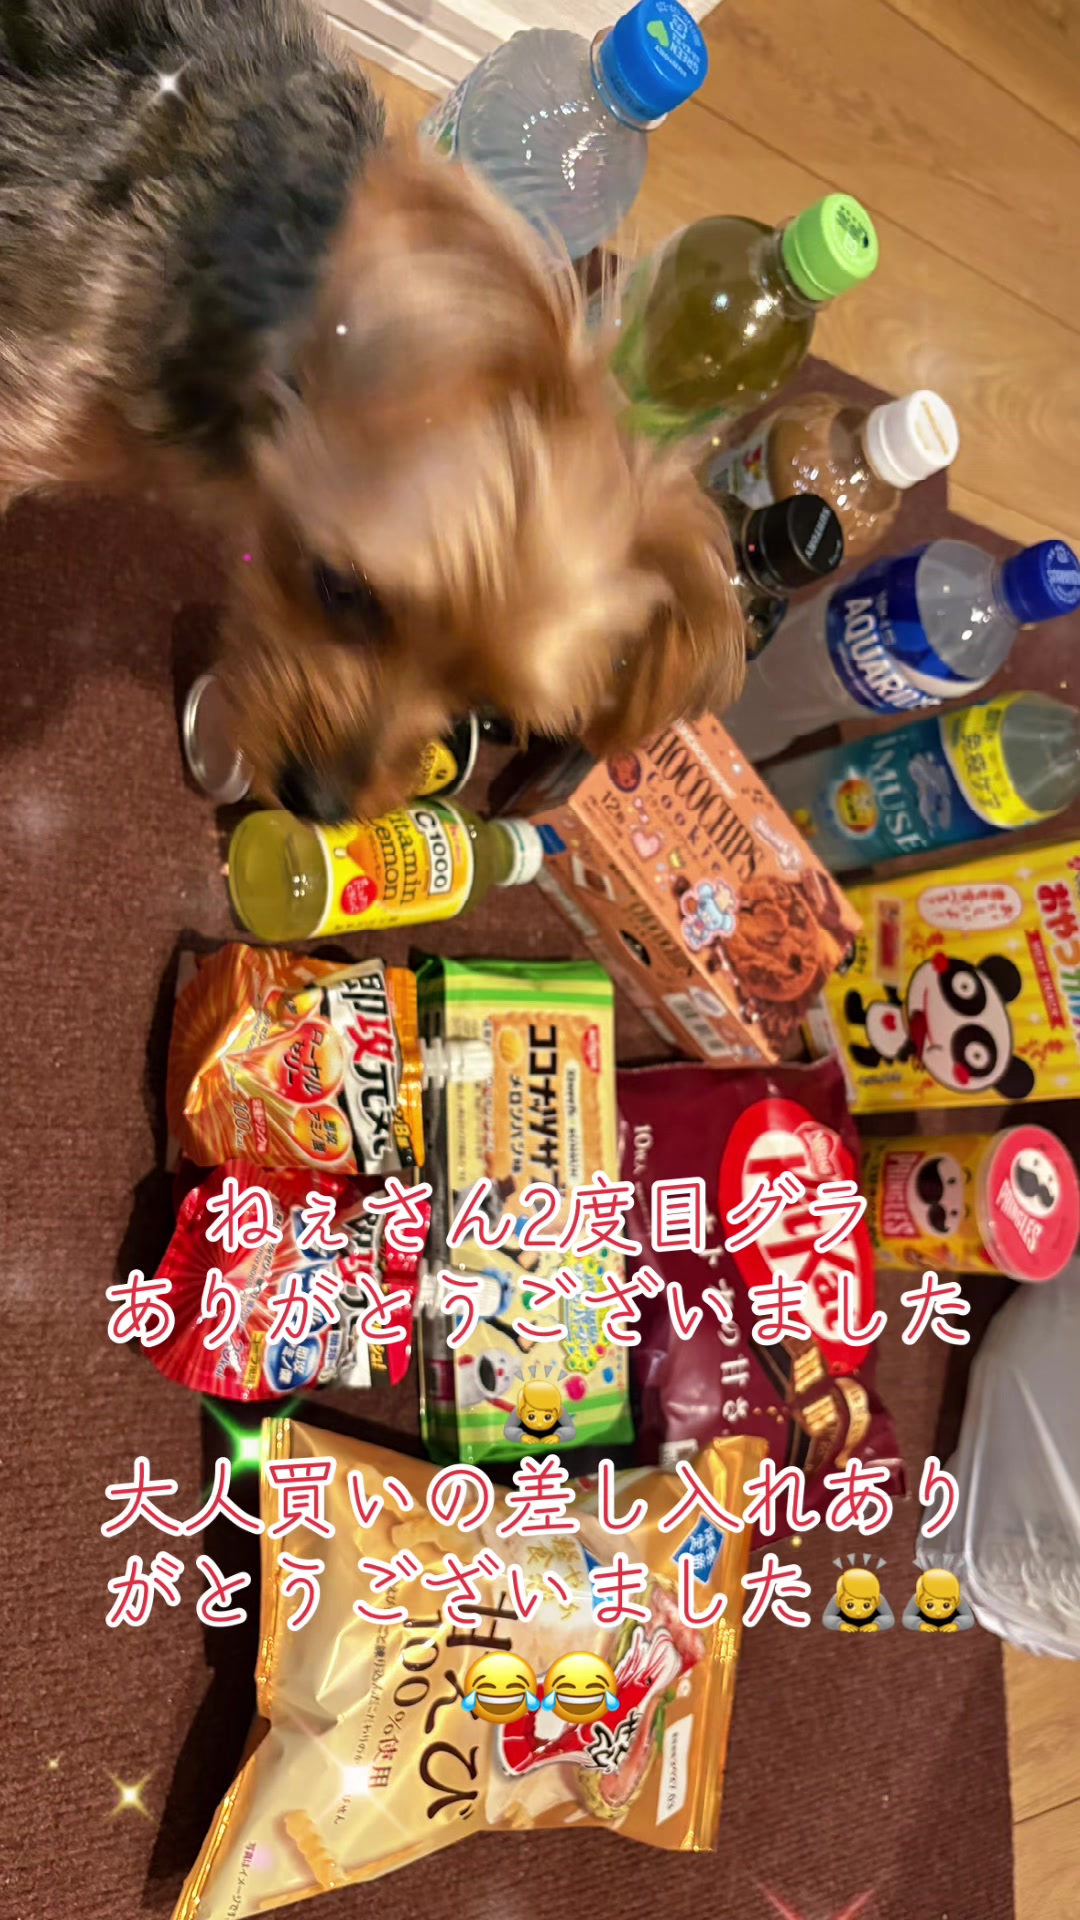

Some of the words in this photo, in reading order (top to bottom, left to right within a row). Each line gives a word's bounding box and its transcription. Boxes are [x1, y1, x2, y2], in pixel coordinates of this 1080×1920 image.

[669, 41, 699, 76] GREEN
[645, 725, 769, 886] HOCOCHIPS
[375, 825, 400, 901] emon
[414, 811, 448, 888] C1000
[282, 1041, 304, 1086] ゼリー
[305, 1029, 323, 1096] ローヤル
[509, 1074, 524, 1173] メロンパン味
[530, 1025, 566, 1196] ココナッツサブ
[885, 1154, 917, 1236] PRINGLES
[996, 1179, 1044, 1254] PRINGLES
[368, 1609, 442, 1790] 100%使用
